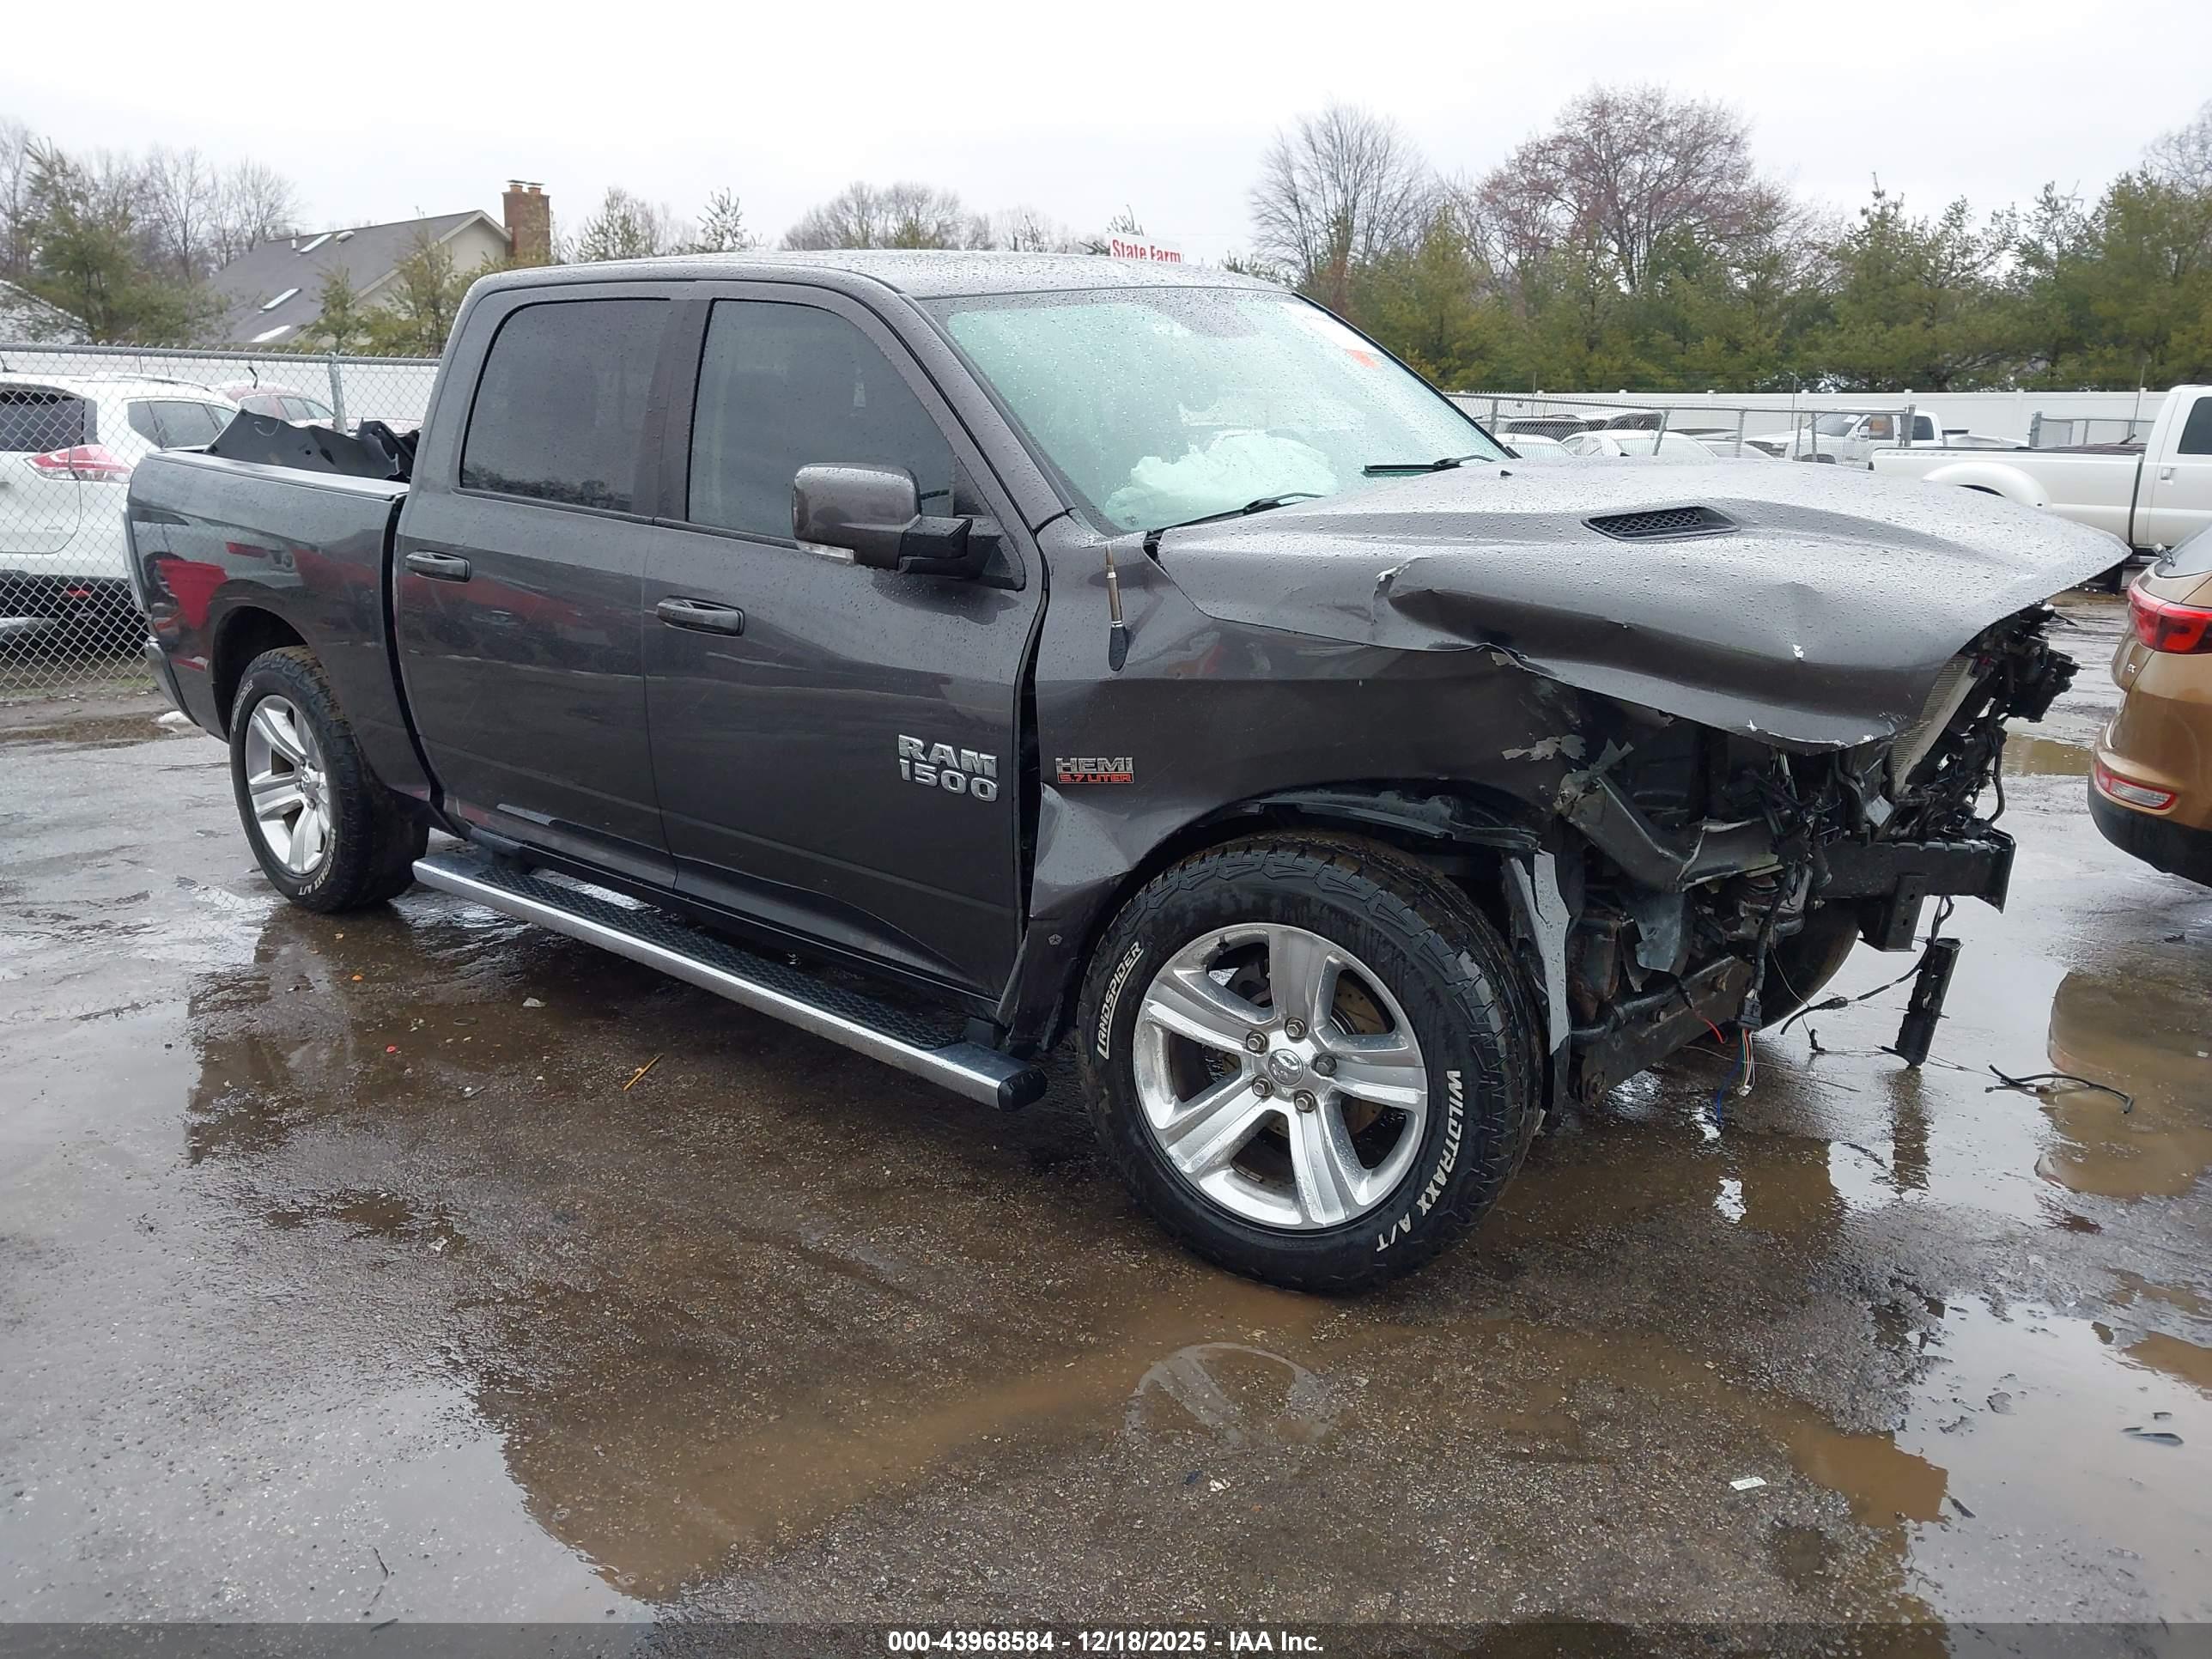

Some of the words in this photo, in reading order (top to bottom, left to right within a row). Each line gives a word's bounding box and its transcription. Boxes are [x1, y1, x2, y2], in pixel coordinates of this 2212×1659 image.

[1112, 239, 1146, 259] State
[1150, 245, 1182, 264] Farm
[898, 734, 999, 778] RAM
[1055, 757, 1133, 773] HEMI
[898, 758, 1000, 802] 1500
[1060, 774, 1085, 782] 5.7
[1087, 774, 1132, 782] LITER
[1097, 940, 1145, 1060] LANDSPIDER
[1416, 1070, 1464, 1217] WILDTRAXX
[1376, 1212, 1412, 1252] A/T
